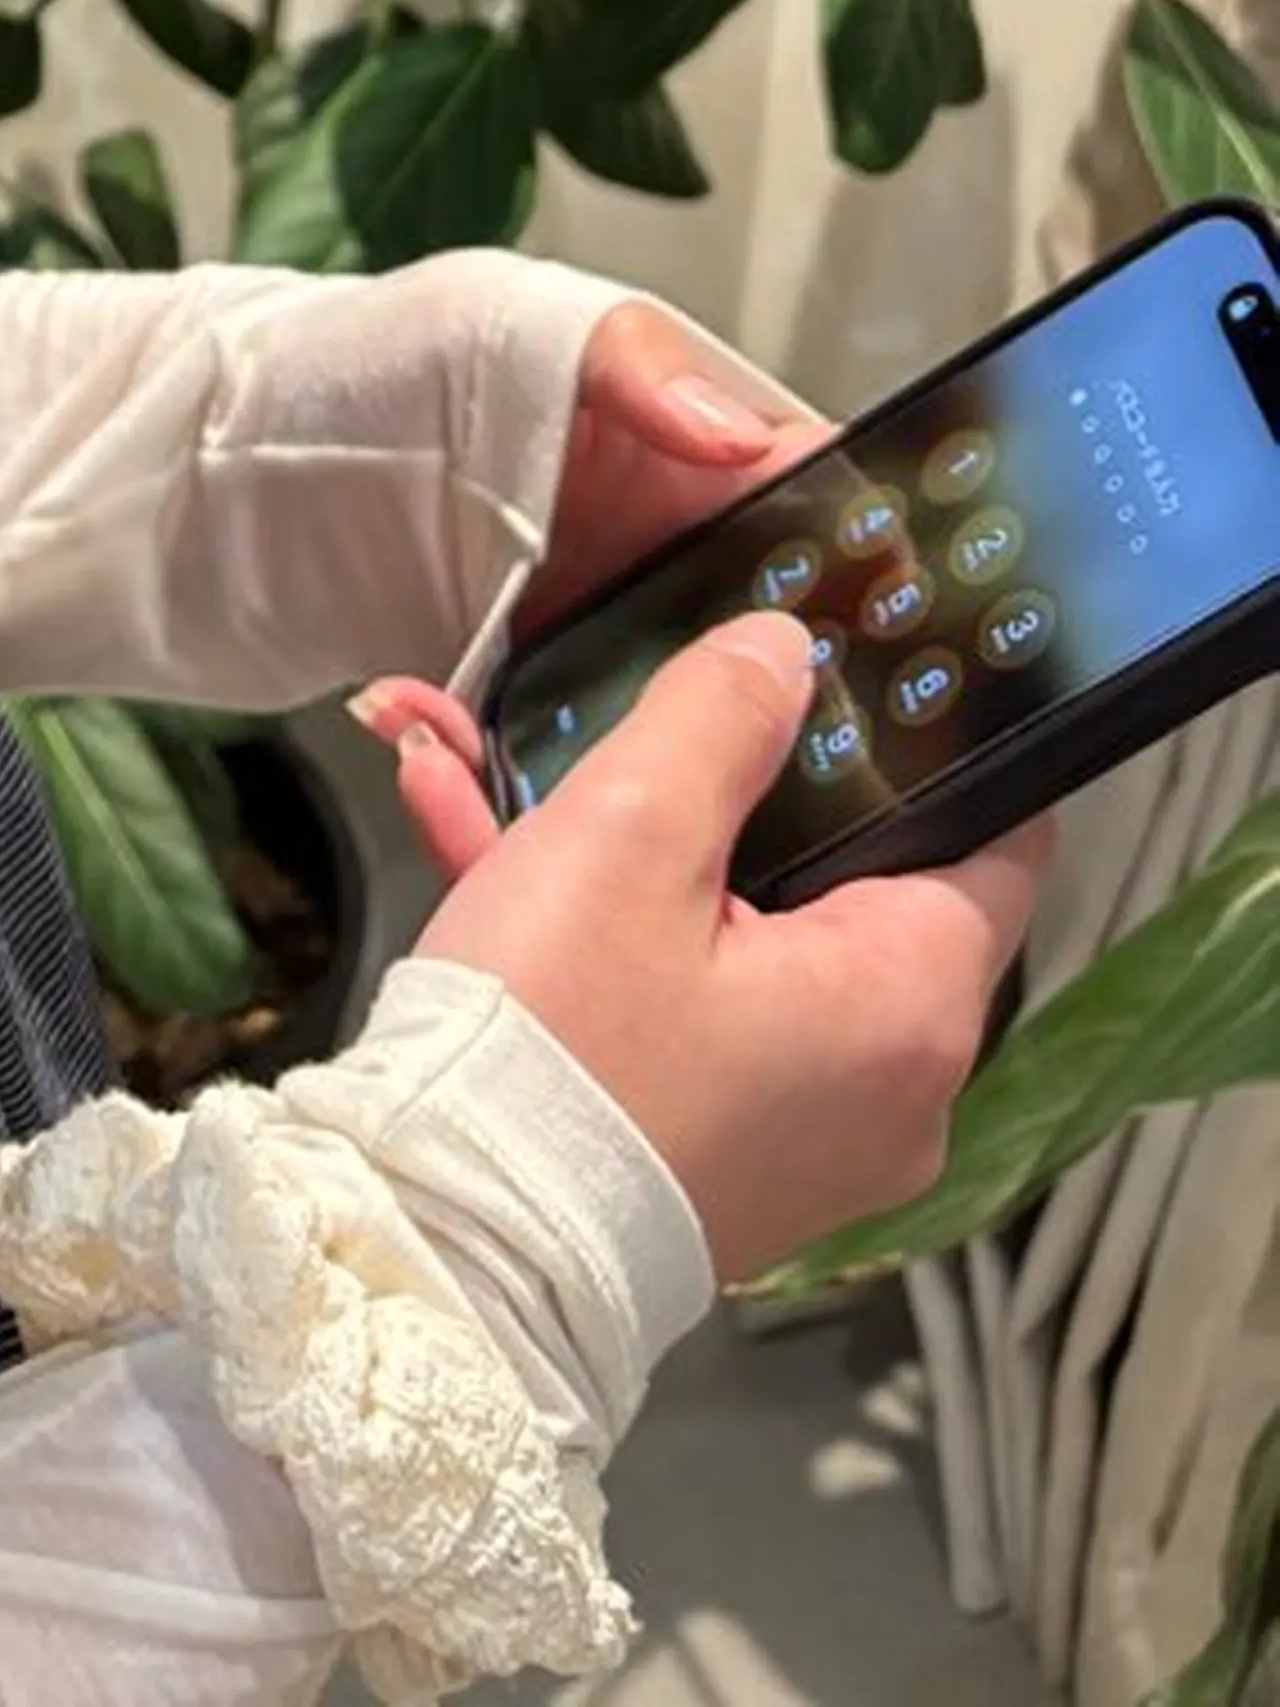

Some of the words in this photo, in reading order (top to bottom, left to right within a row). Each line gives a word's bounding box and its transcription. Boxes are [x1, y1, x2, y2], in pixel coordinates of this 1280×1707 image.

[949, 451, 977, 474] 1
[865, 507, 894, 532] 4
[978, 528, 1009, 559] 2
[778, 555, 811, 580] 7
[890, 583, 921, 614] 5
[1006, 610, 1040, 641] 3
[916, 667, 950, 699] 6
[827, 723, 858, 754] 9
